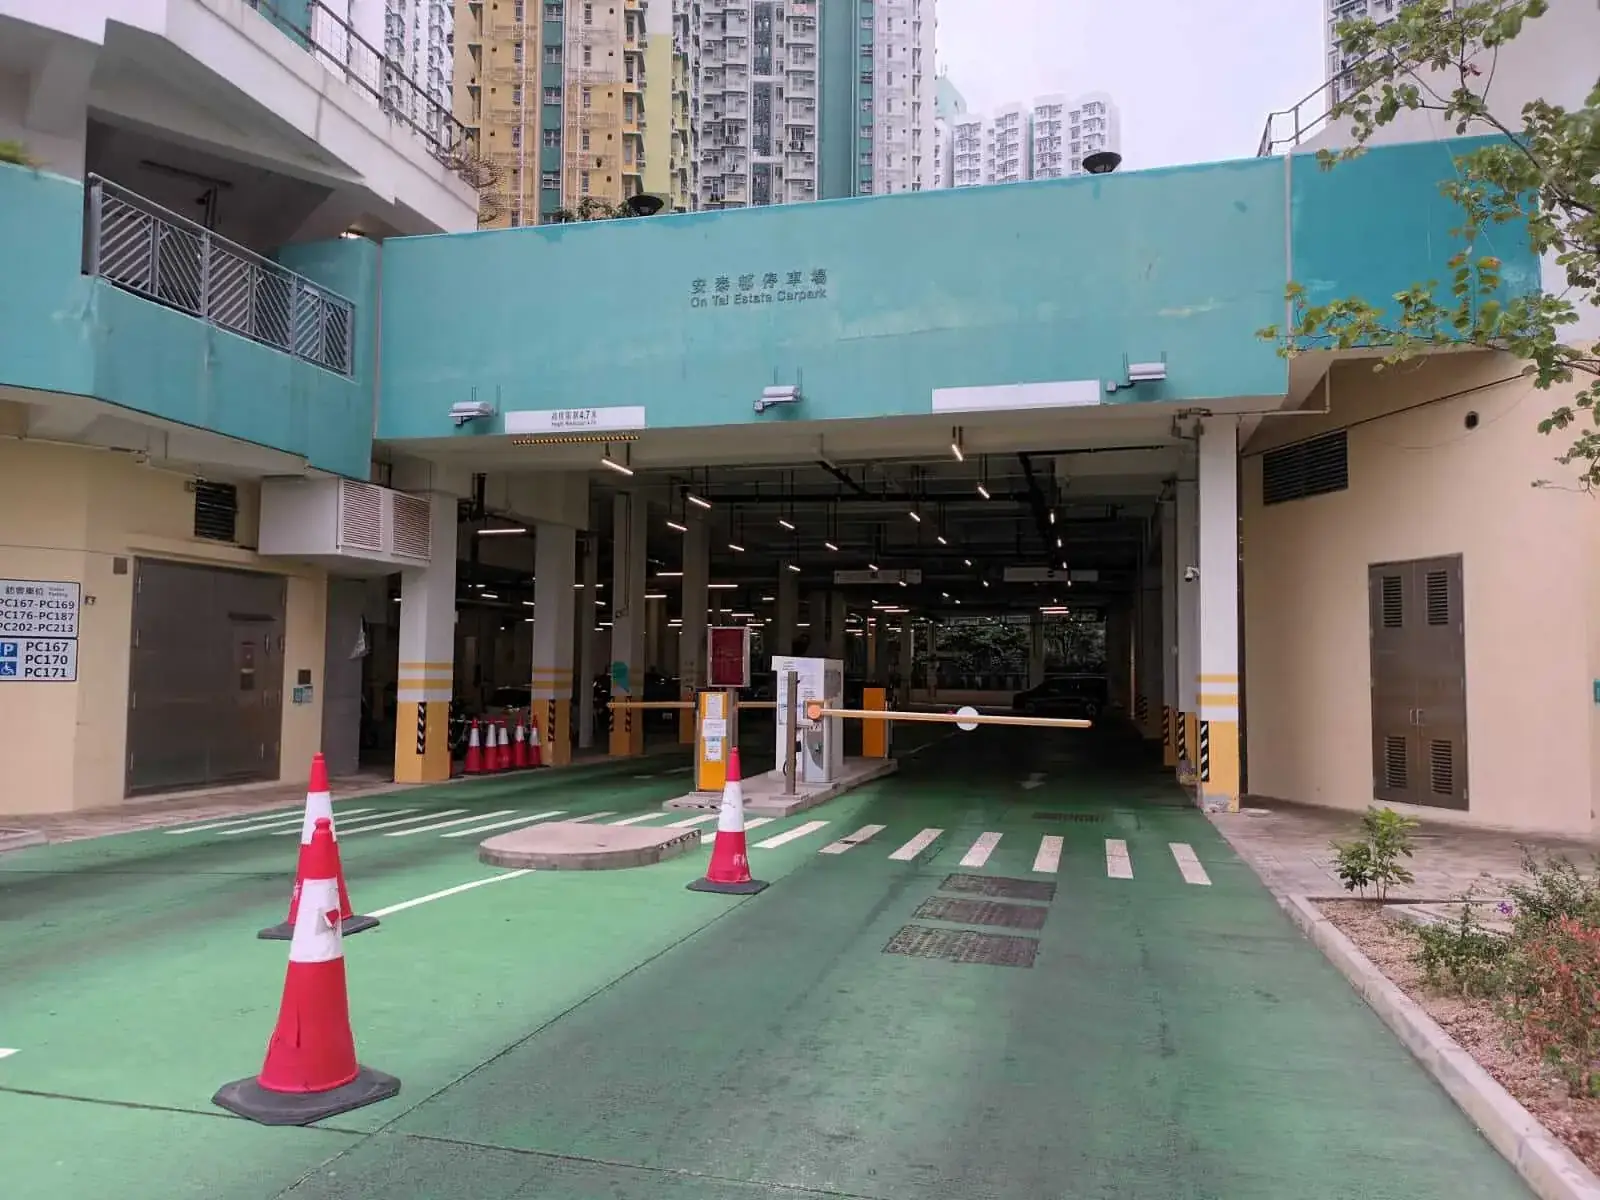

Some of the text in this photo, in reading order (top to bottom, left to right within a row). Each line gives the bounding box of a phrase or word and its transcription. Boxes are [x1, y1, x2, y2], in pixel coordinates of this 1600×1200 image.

[690, 297, 708, 308] On
[733, 292, 773, 305] Estate
[776, 288, 827, 303] Carpark
[26, 641, 69, 652] PC167
[25, 654, 68, 665] PC170
[24, 667, 66, 678] PC171
